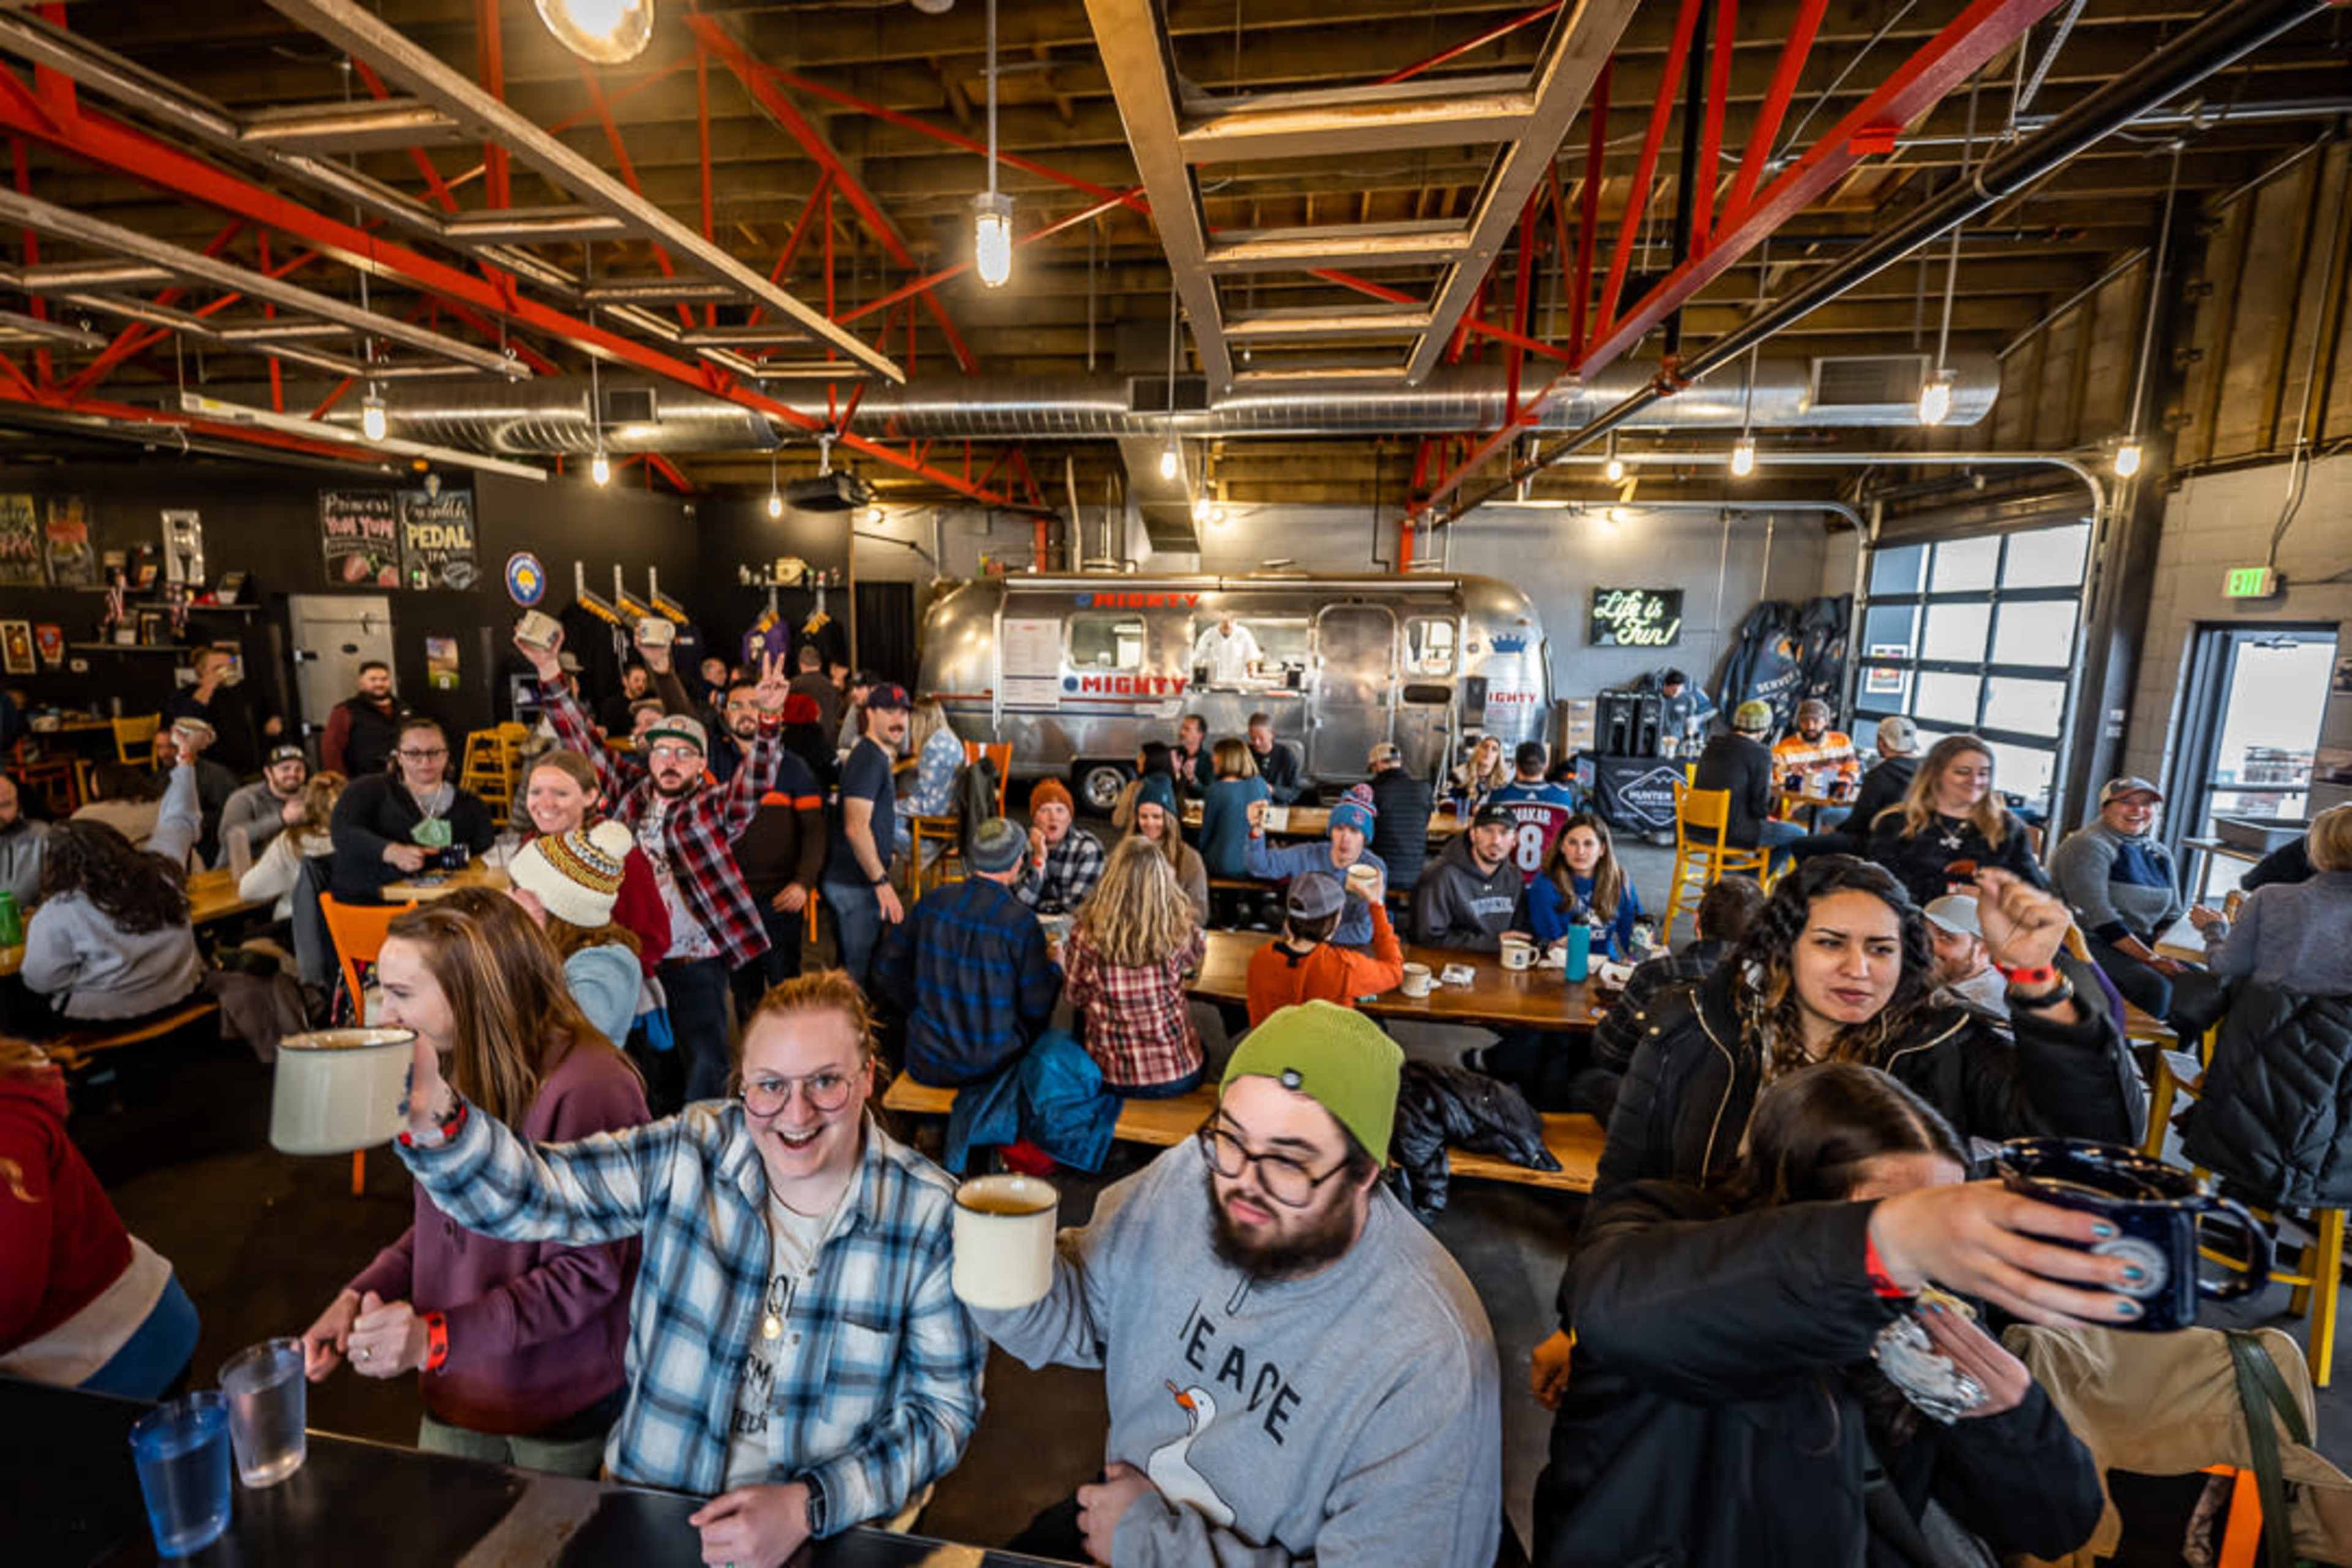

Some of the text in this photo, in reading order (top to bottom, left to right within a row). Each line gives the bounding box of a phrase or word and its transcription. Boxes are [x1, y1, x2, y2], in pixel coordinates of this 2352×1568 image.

[359, 516, 394, 539] YUM
[407, 524, 472, 549] PEDAL
[2229, 569, 2265, 597] EXIT
[1093, 592, 1199, 608] MIGHTY
[1594, 590, 1664, 628] Life is
[1616, 617, 1681, 645] Fun!
[1082, 676, 1188, 696] MIGHTY
[1488, 692, 1537, 703] IGHTY
[1517, 824, 1544, 872] 8
